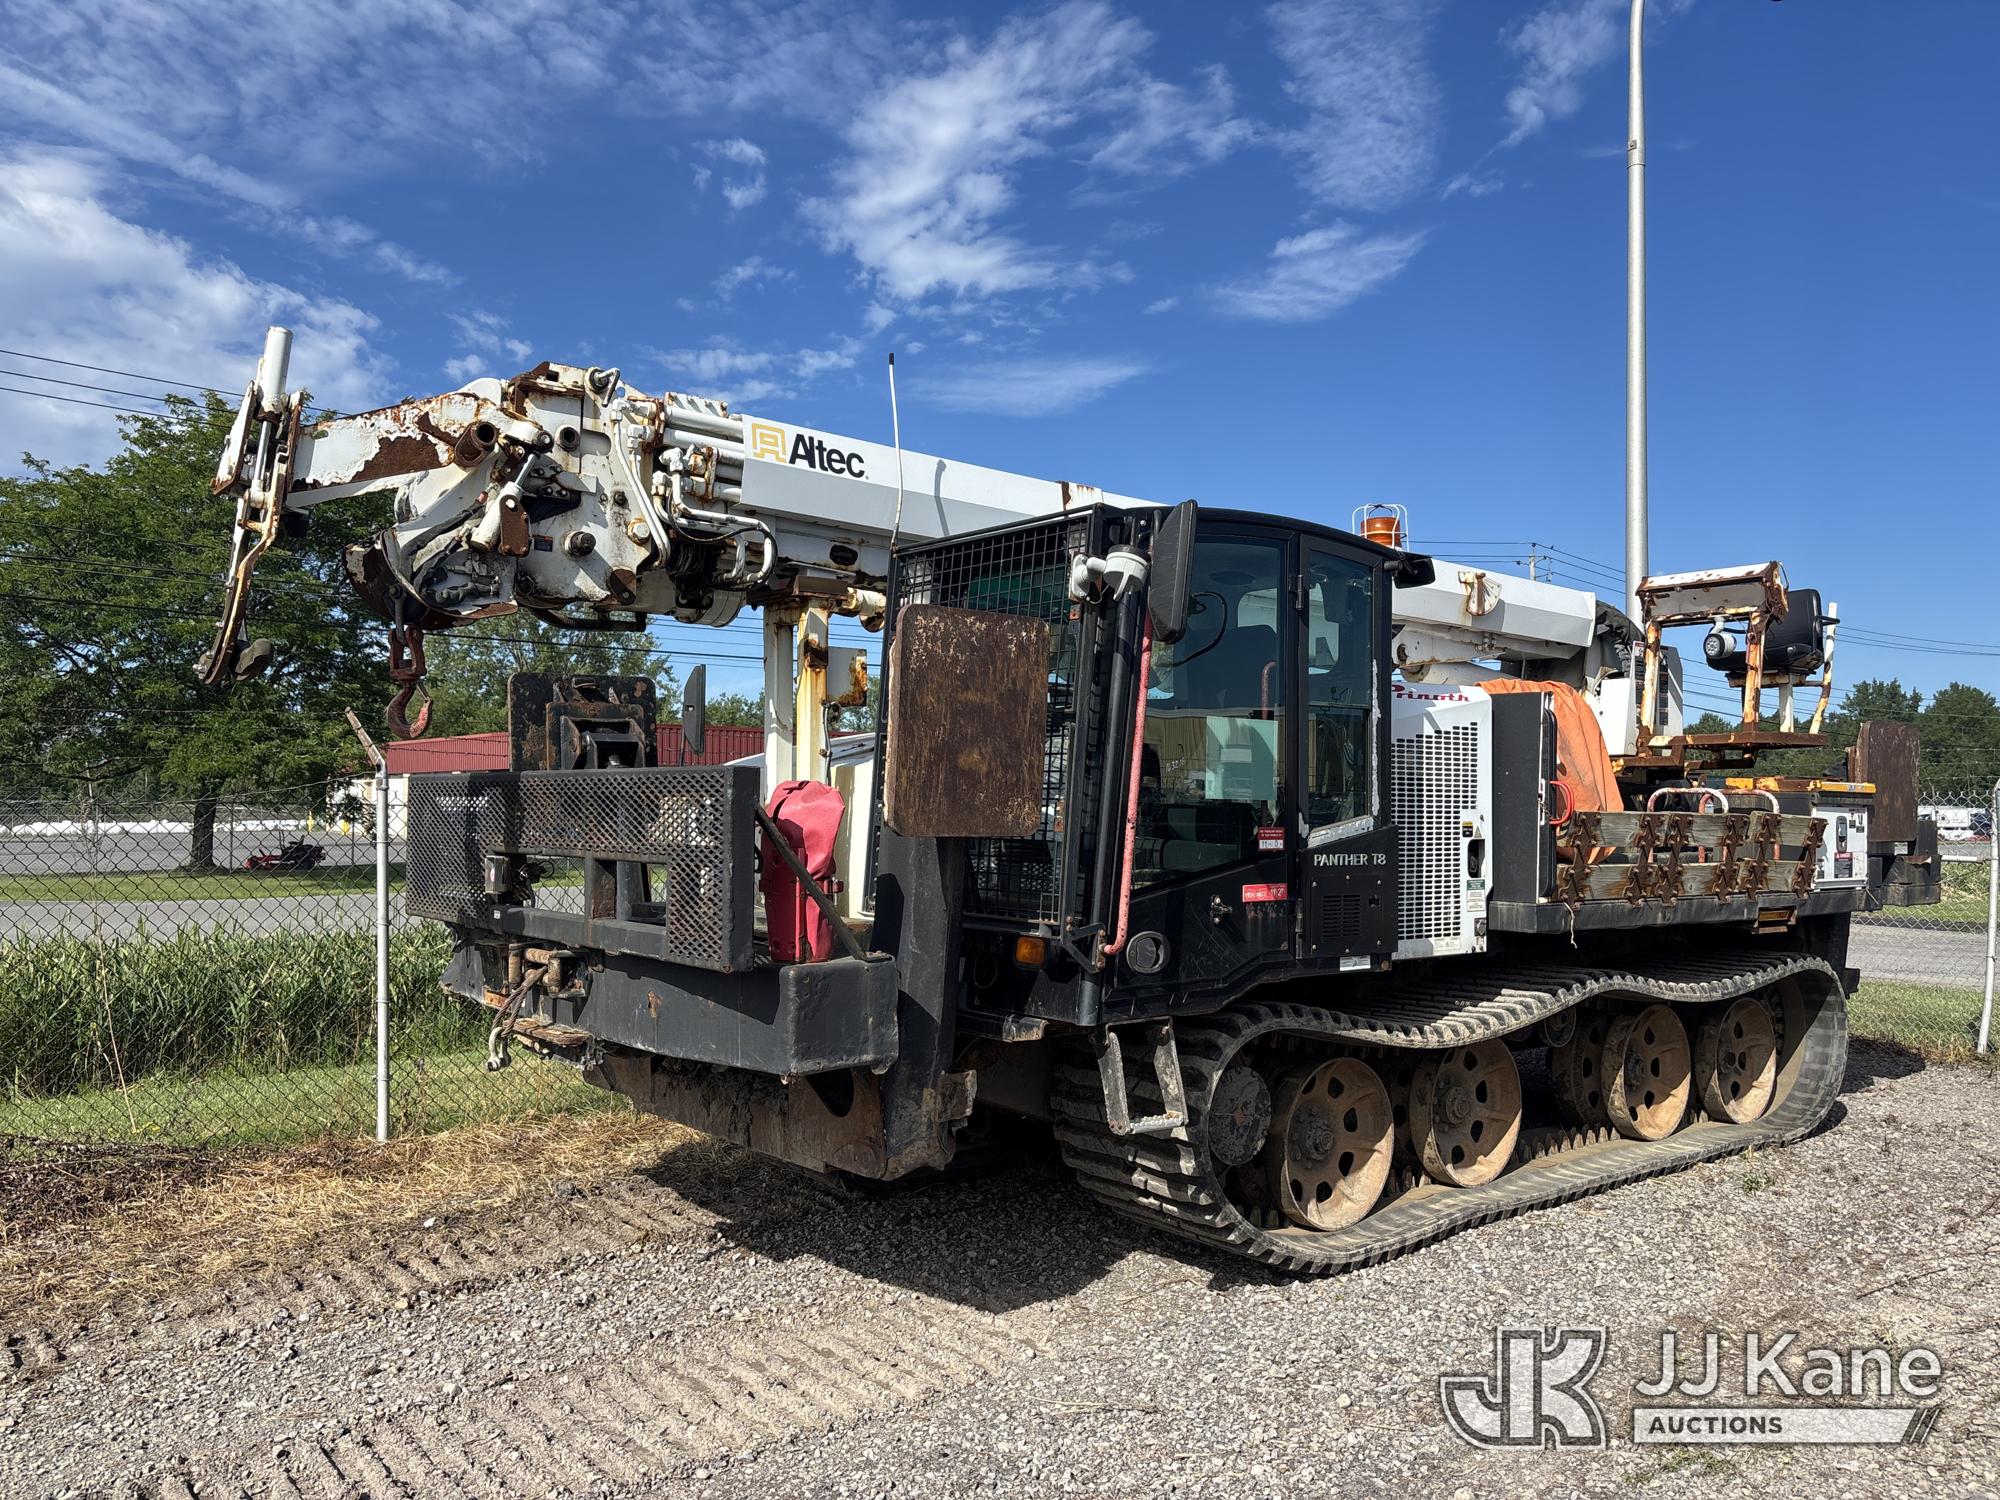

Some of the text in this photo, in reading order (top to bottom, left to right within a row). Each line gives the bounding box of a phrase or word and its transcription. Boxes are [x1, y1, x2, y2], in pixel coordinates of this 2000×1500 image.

[789, 433, 866, 479] Altec
[1314, 853, 1387, 866] PANTHER T8
